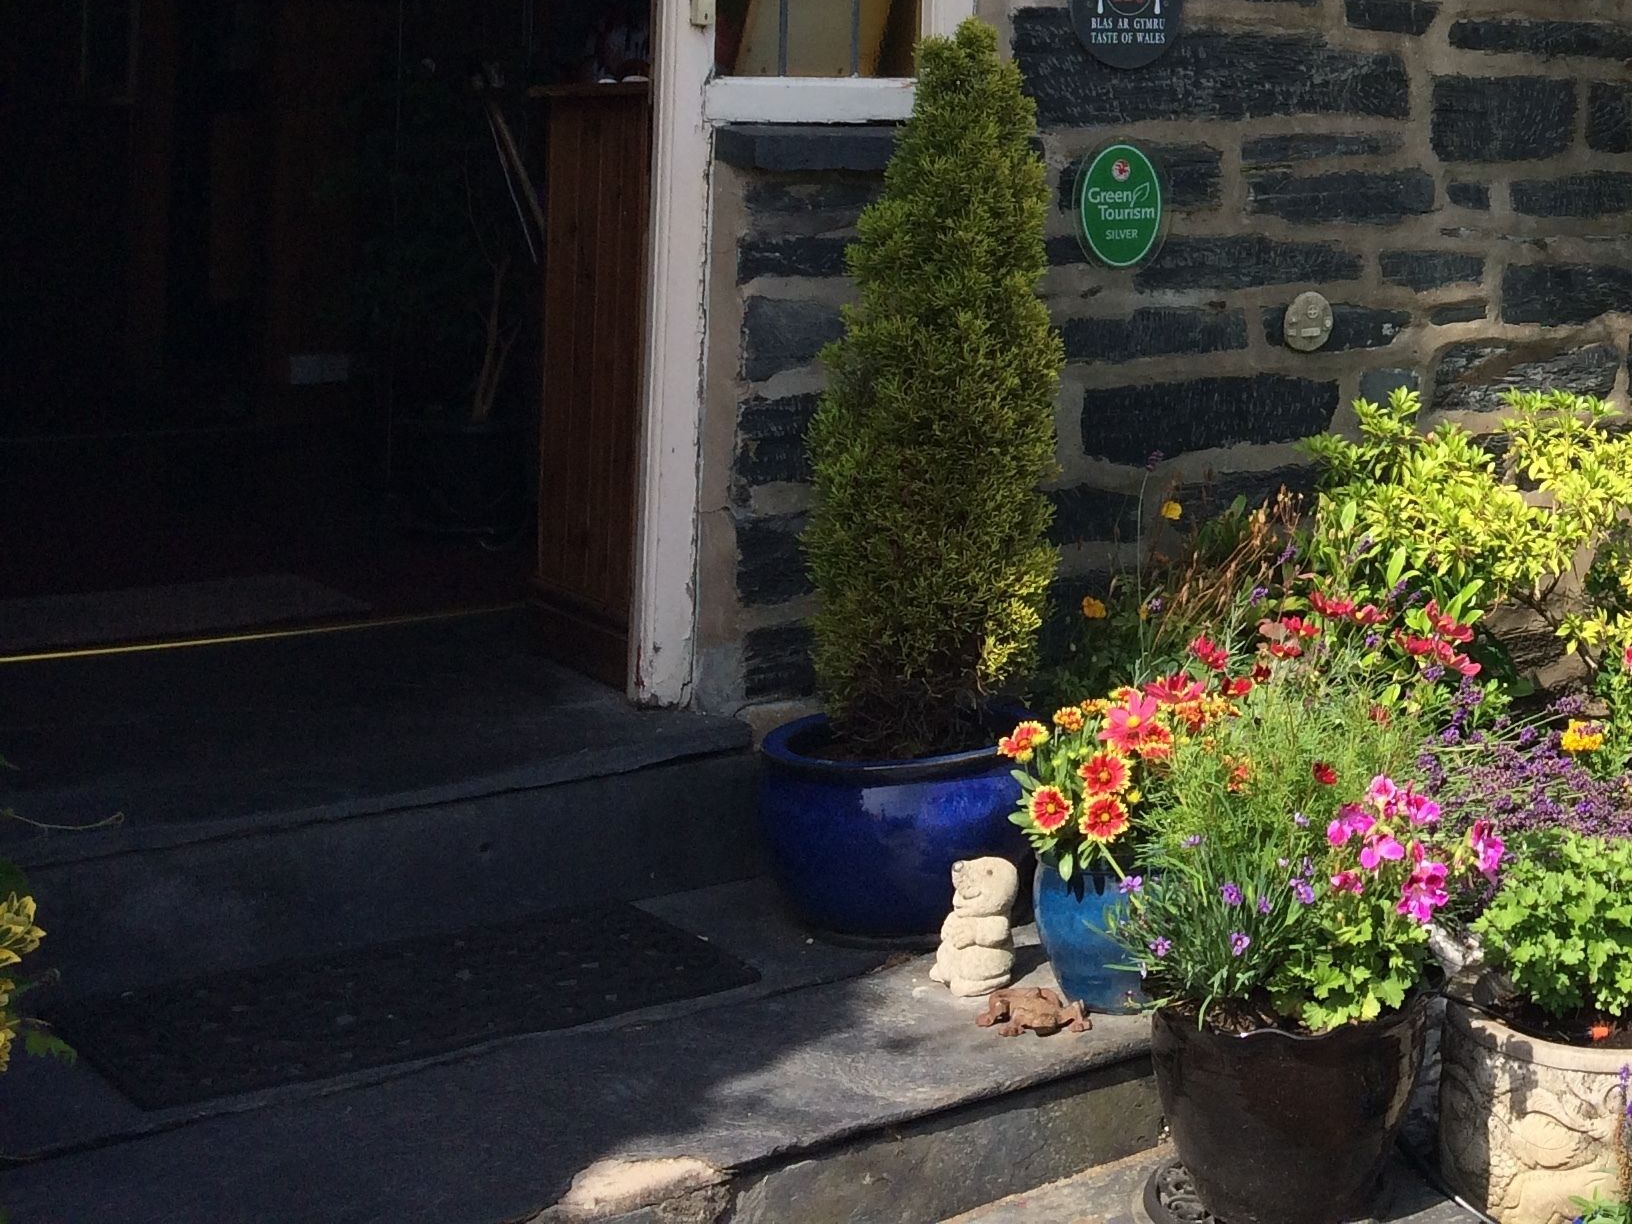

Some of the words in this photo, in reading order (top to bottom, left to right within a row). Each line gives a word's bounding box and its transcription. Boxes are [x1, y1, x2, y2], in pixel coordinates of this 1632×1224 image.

[1091, 17, 1113, 29] BLAS
[1117, 18, 1129, 29] AR
[1133, 18, 1165, 29] GYMRU
[1090, 32, 1118, 44] TASTE
[1121, 32, 1133, 44] OF
[1136, 32, 1165, 44] WALES
[1088, 187, 1131, 203] Green
[1098, 205, 1155, 221] Tourism
[1105, 229, 1138, 240] SILVER
